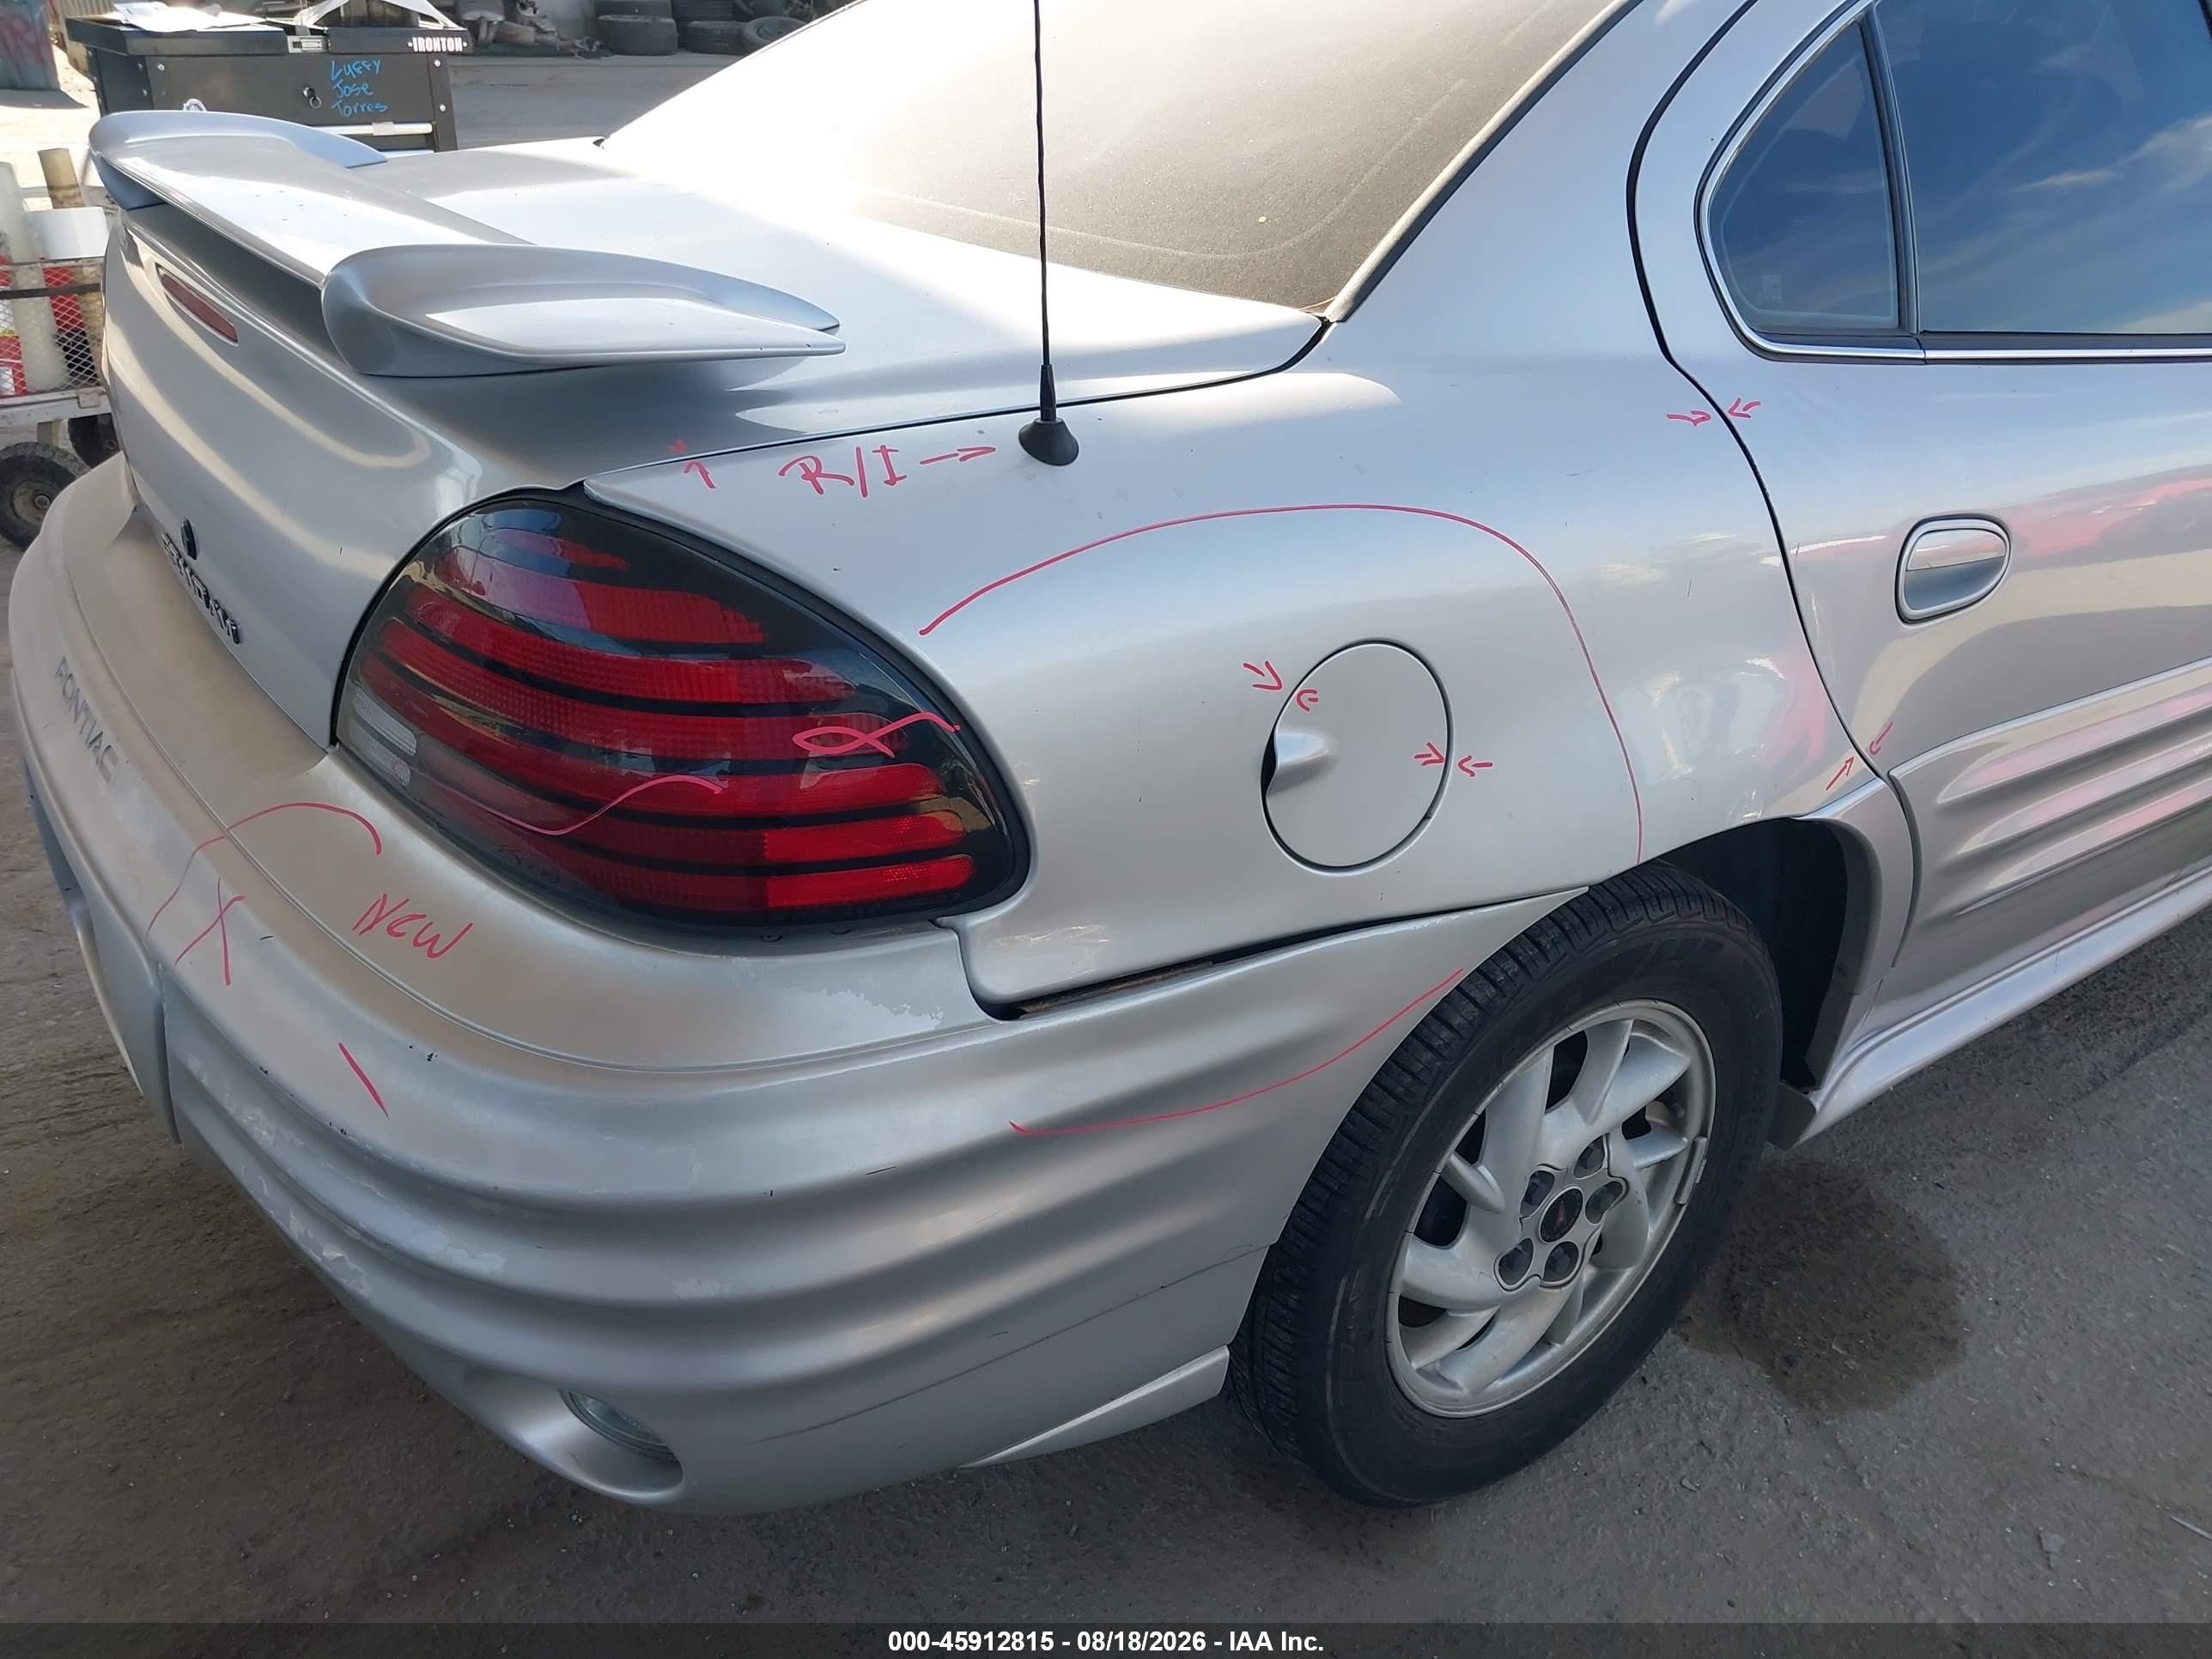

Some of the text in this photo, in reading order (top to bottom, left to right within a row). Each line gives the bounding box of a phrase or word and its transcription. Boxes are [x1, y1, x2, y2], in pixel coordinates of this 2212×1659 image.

[411, 36, 464, 52] IRONTON
[332, 78, 374, 99] Jose
[331, 99, 388, 118] Torres
[54, 655, 119, 785] PONTIAC
